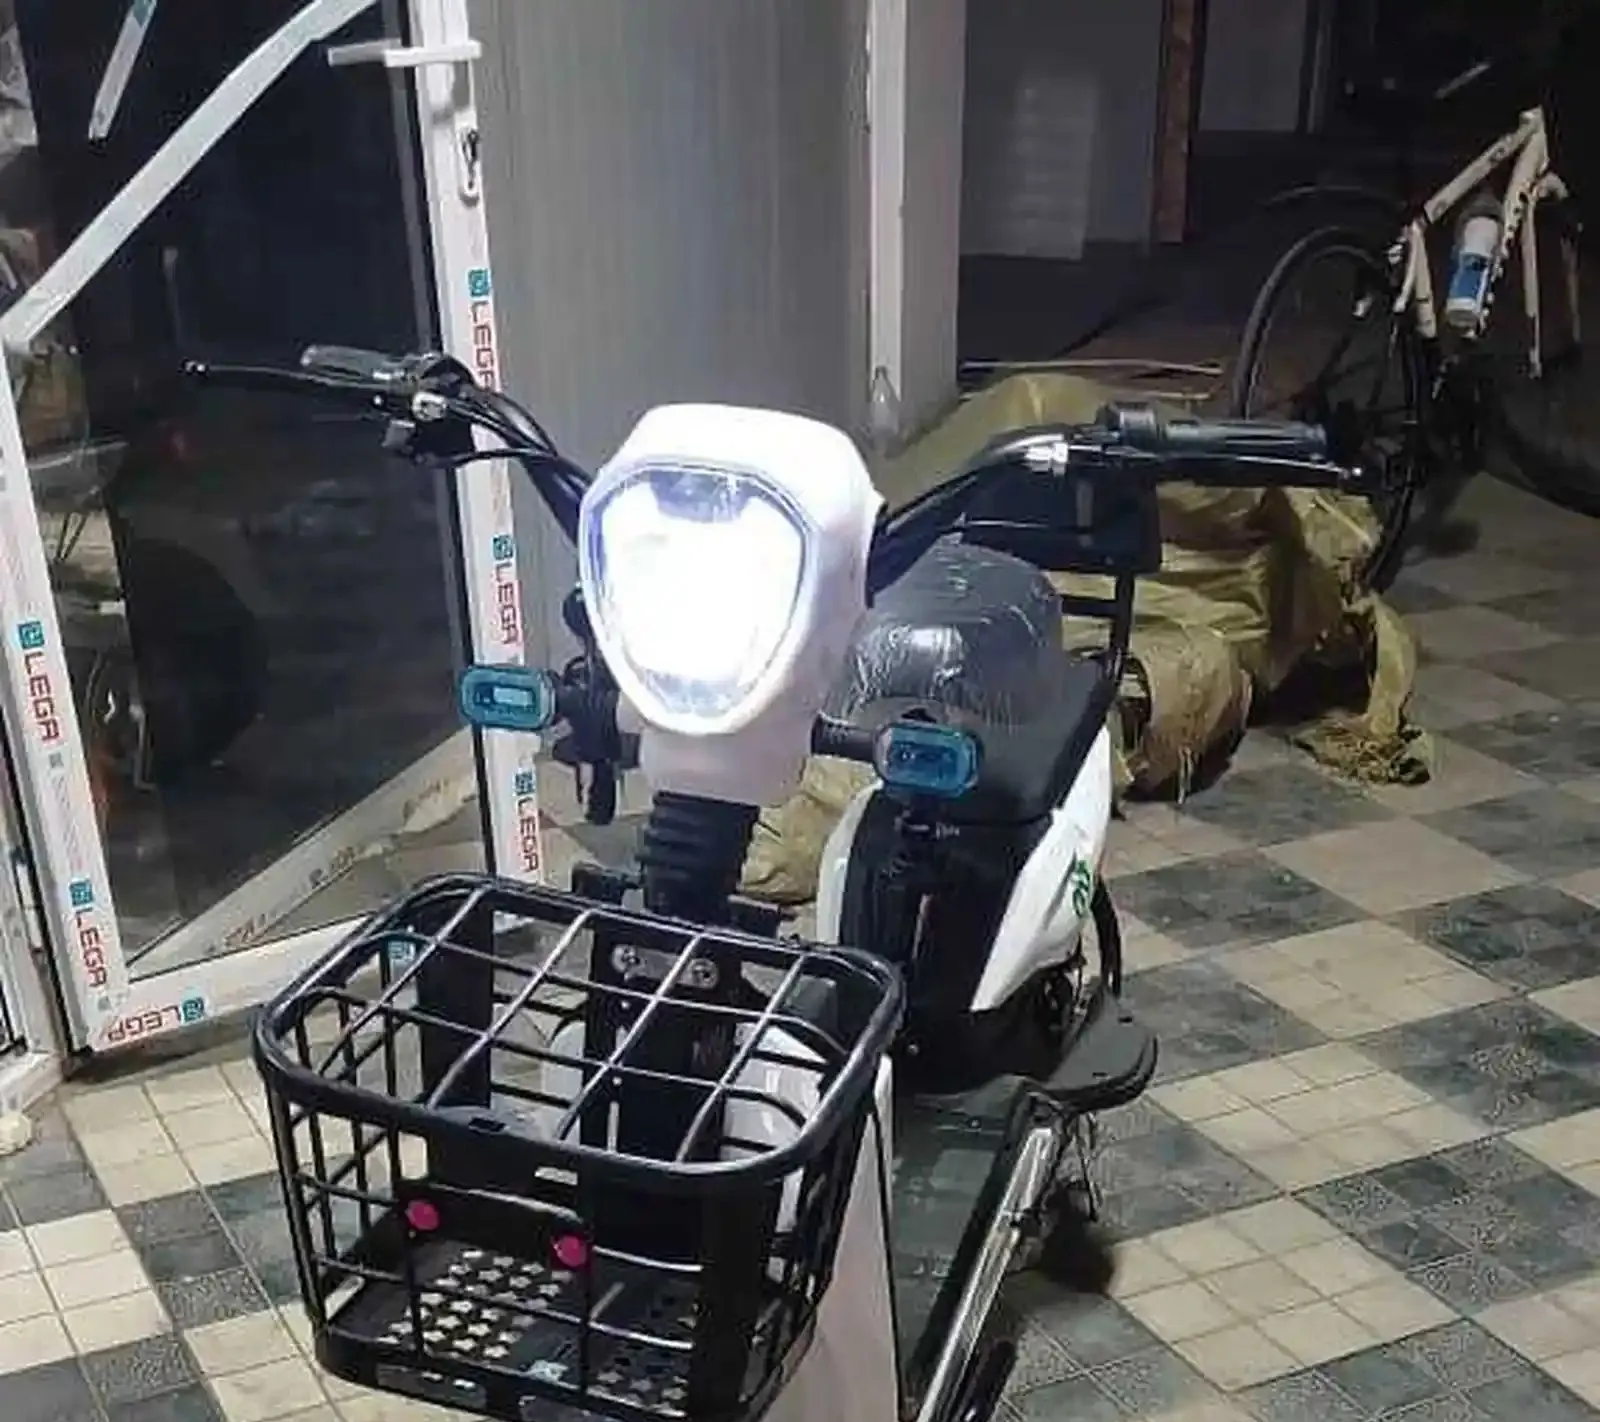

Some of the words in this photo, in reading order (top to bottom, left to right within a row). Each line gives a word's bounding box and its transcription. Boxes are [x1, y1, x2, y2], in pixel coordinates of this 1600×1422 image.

[495, 561, 519, 644] LEGA
[24, 651, 60, 741] LEGA
[518, 796, 539, 872] LEGA
[75, 907, 107, 987] LEGA
[107, 1004, 181, 1041] LEGA
